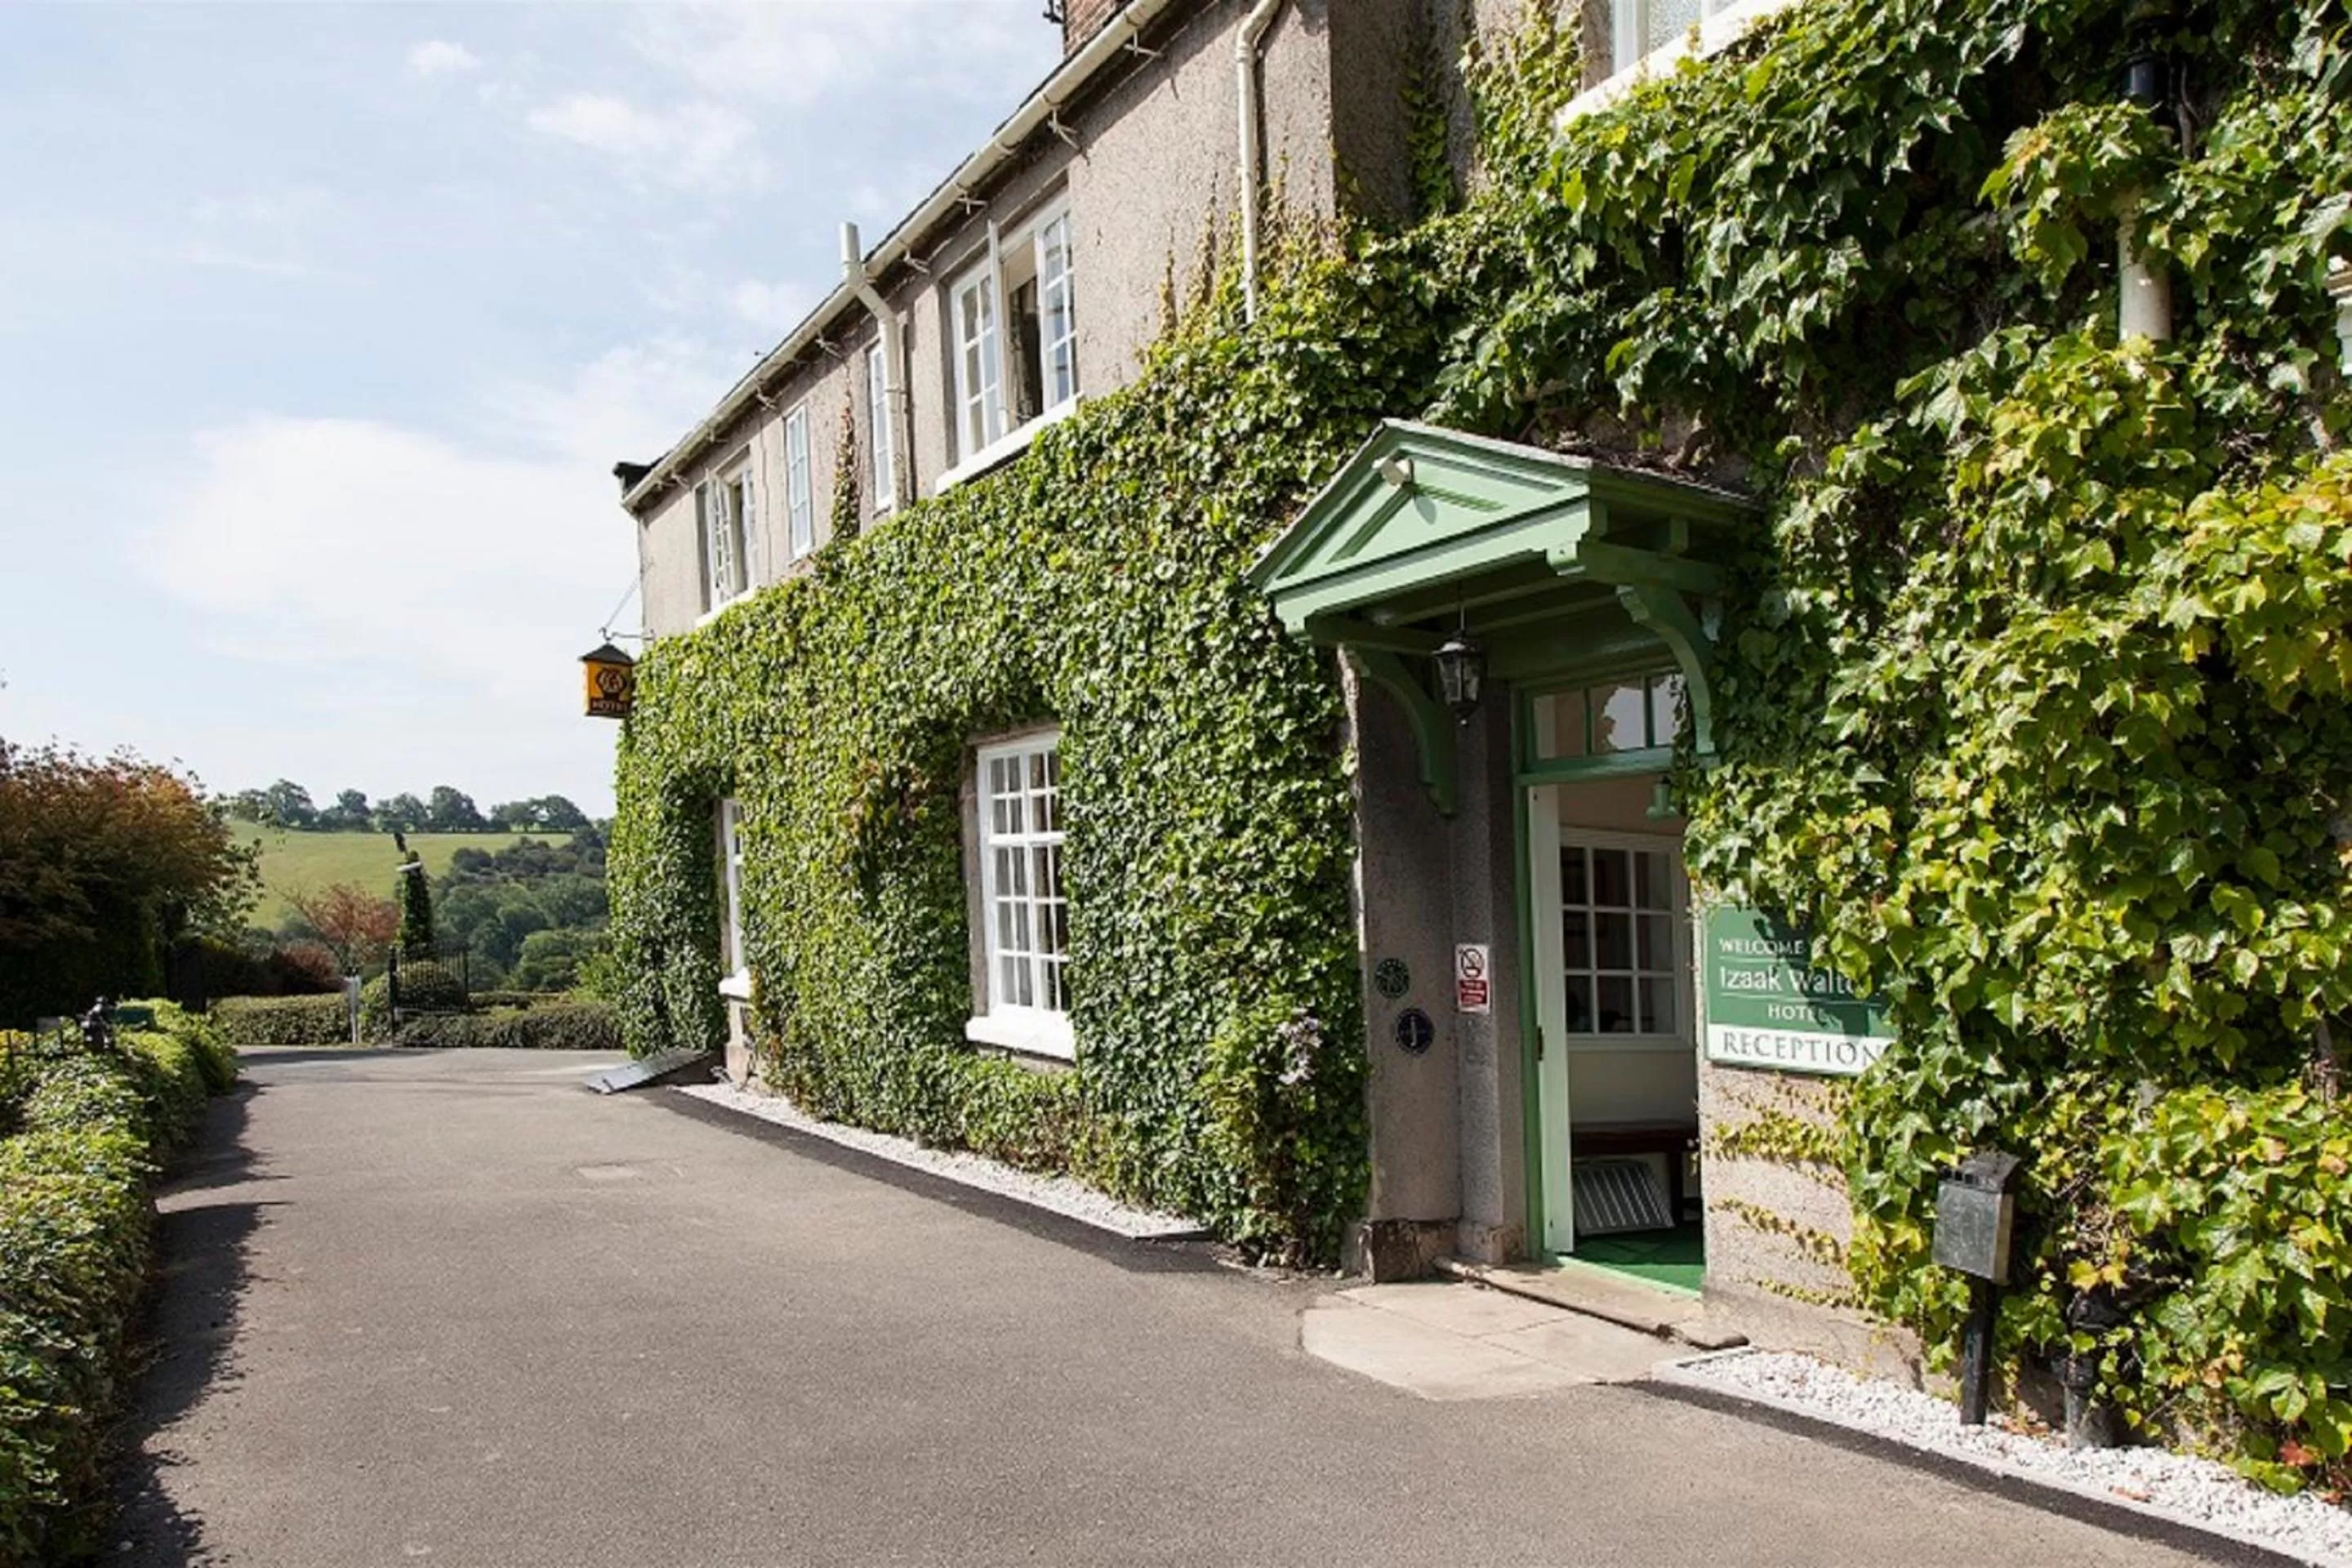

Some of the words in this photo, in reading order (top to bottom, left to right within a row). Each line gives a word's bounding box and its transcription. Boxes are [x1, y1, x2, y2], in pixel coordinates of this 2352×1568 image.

[1719, 938, 1805, 956] WELCOME
[1720, 964, 1783, 991] Izaak
[1768, 1005, 1829, 1023] HOTEL
[1723, 1031, 1882, 1067] RECEPTION
